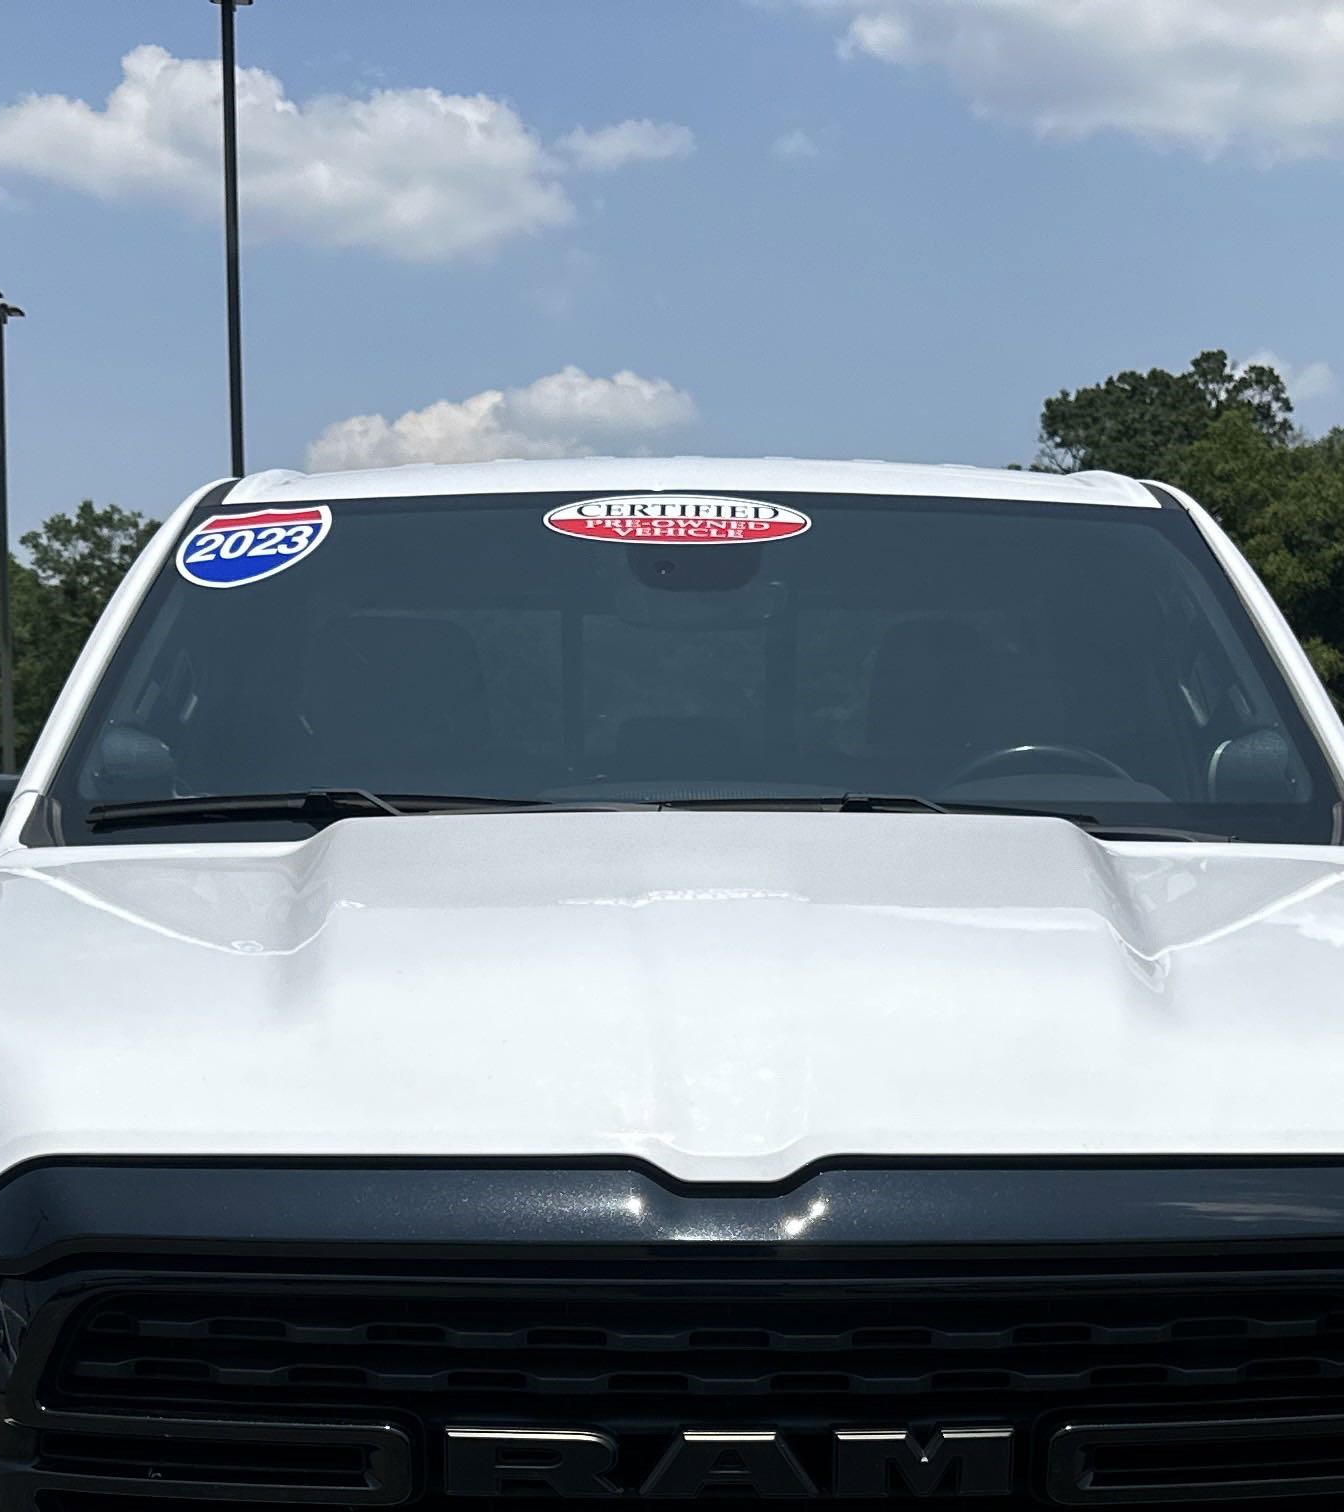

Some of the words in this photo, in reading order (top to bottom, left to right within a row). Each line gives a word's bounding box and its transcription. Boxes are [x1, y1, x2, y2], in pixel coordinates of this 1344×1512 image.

[576, 503, 780, 520] CERTIFIED
[585, 519, 771, 531] PRE-OWNED
[612, 527, 745, 539] VEHICLE
[185, 525, 314, 564] 2023
[445, 1426, 1016, 1498] RAM
